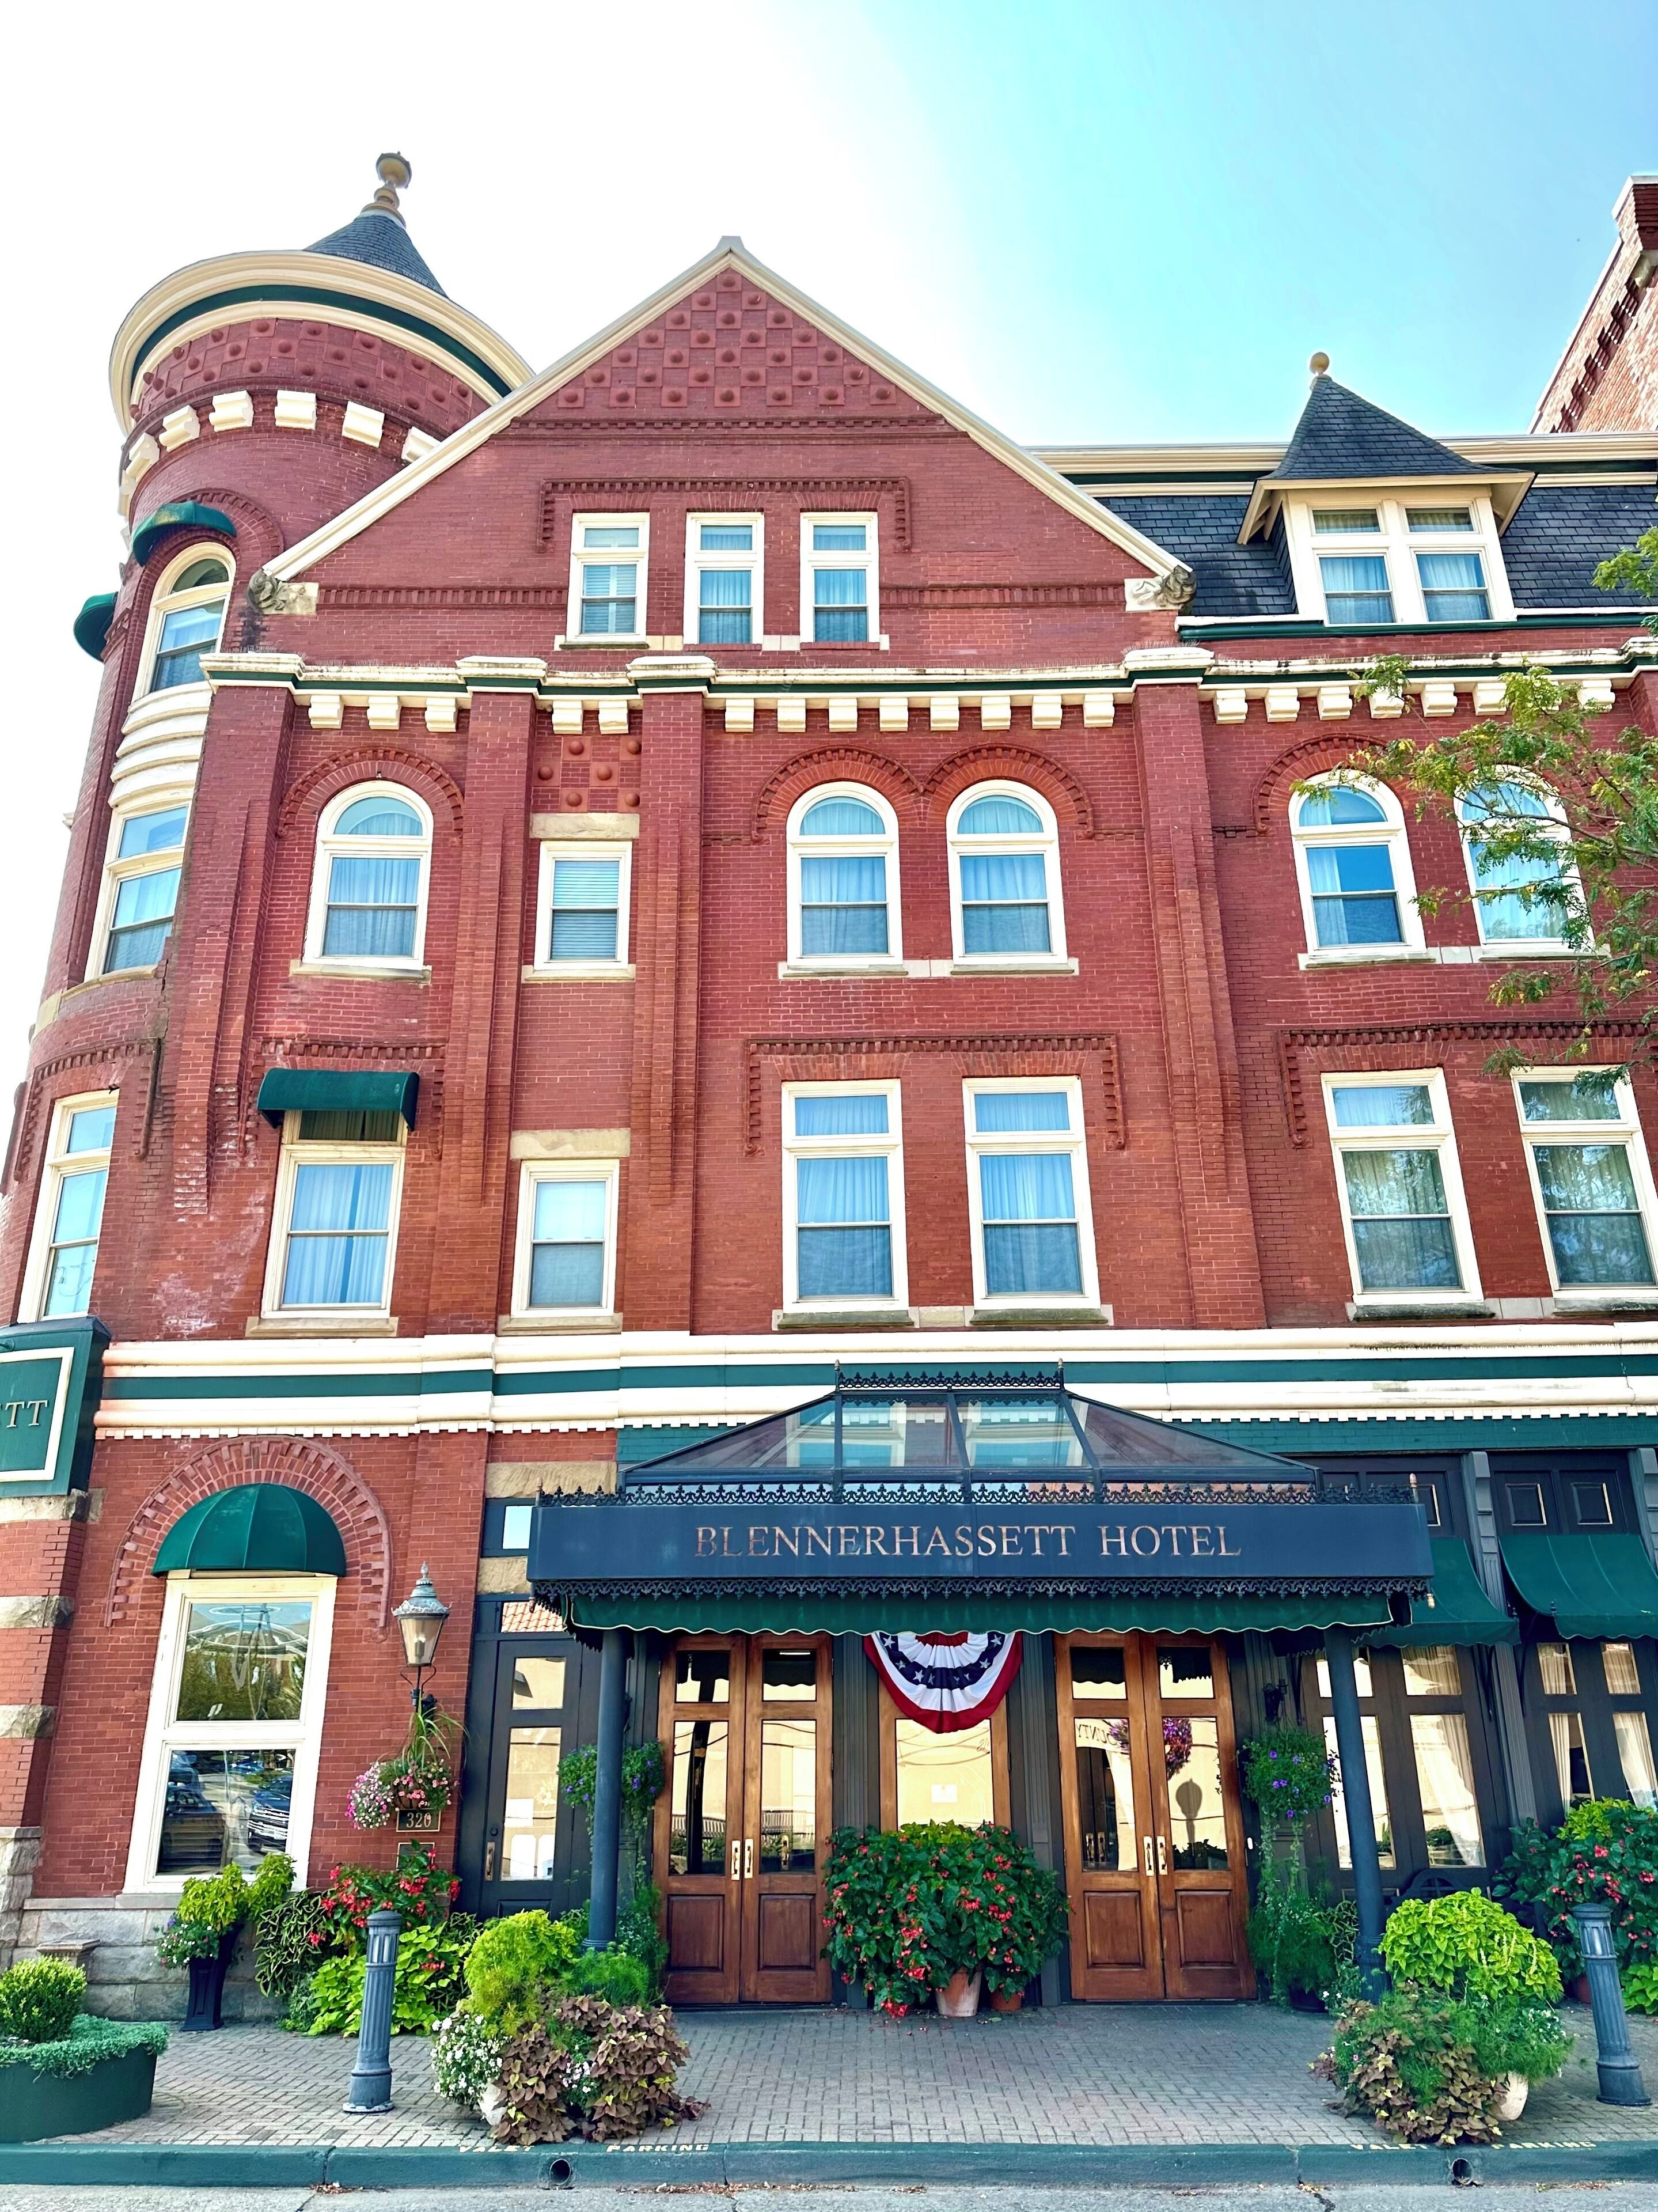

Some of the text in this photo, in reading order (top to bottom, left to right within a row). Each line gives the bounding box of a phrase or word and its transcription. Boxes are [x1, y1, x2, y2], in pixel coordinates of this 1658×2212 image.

[0, 1399, 48, 1428] TT
[694, 1525, 1241, 1557] BLENNERHASSETT HOTEL
[406, 1812, 431, 1828] 320
[459, 2144, 709, 2153] VALET PARKING
